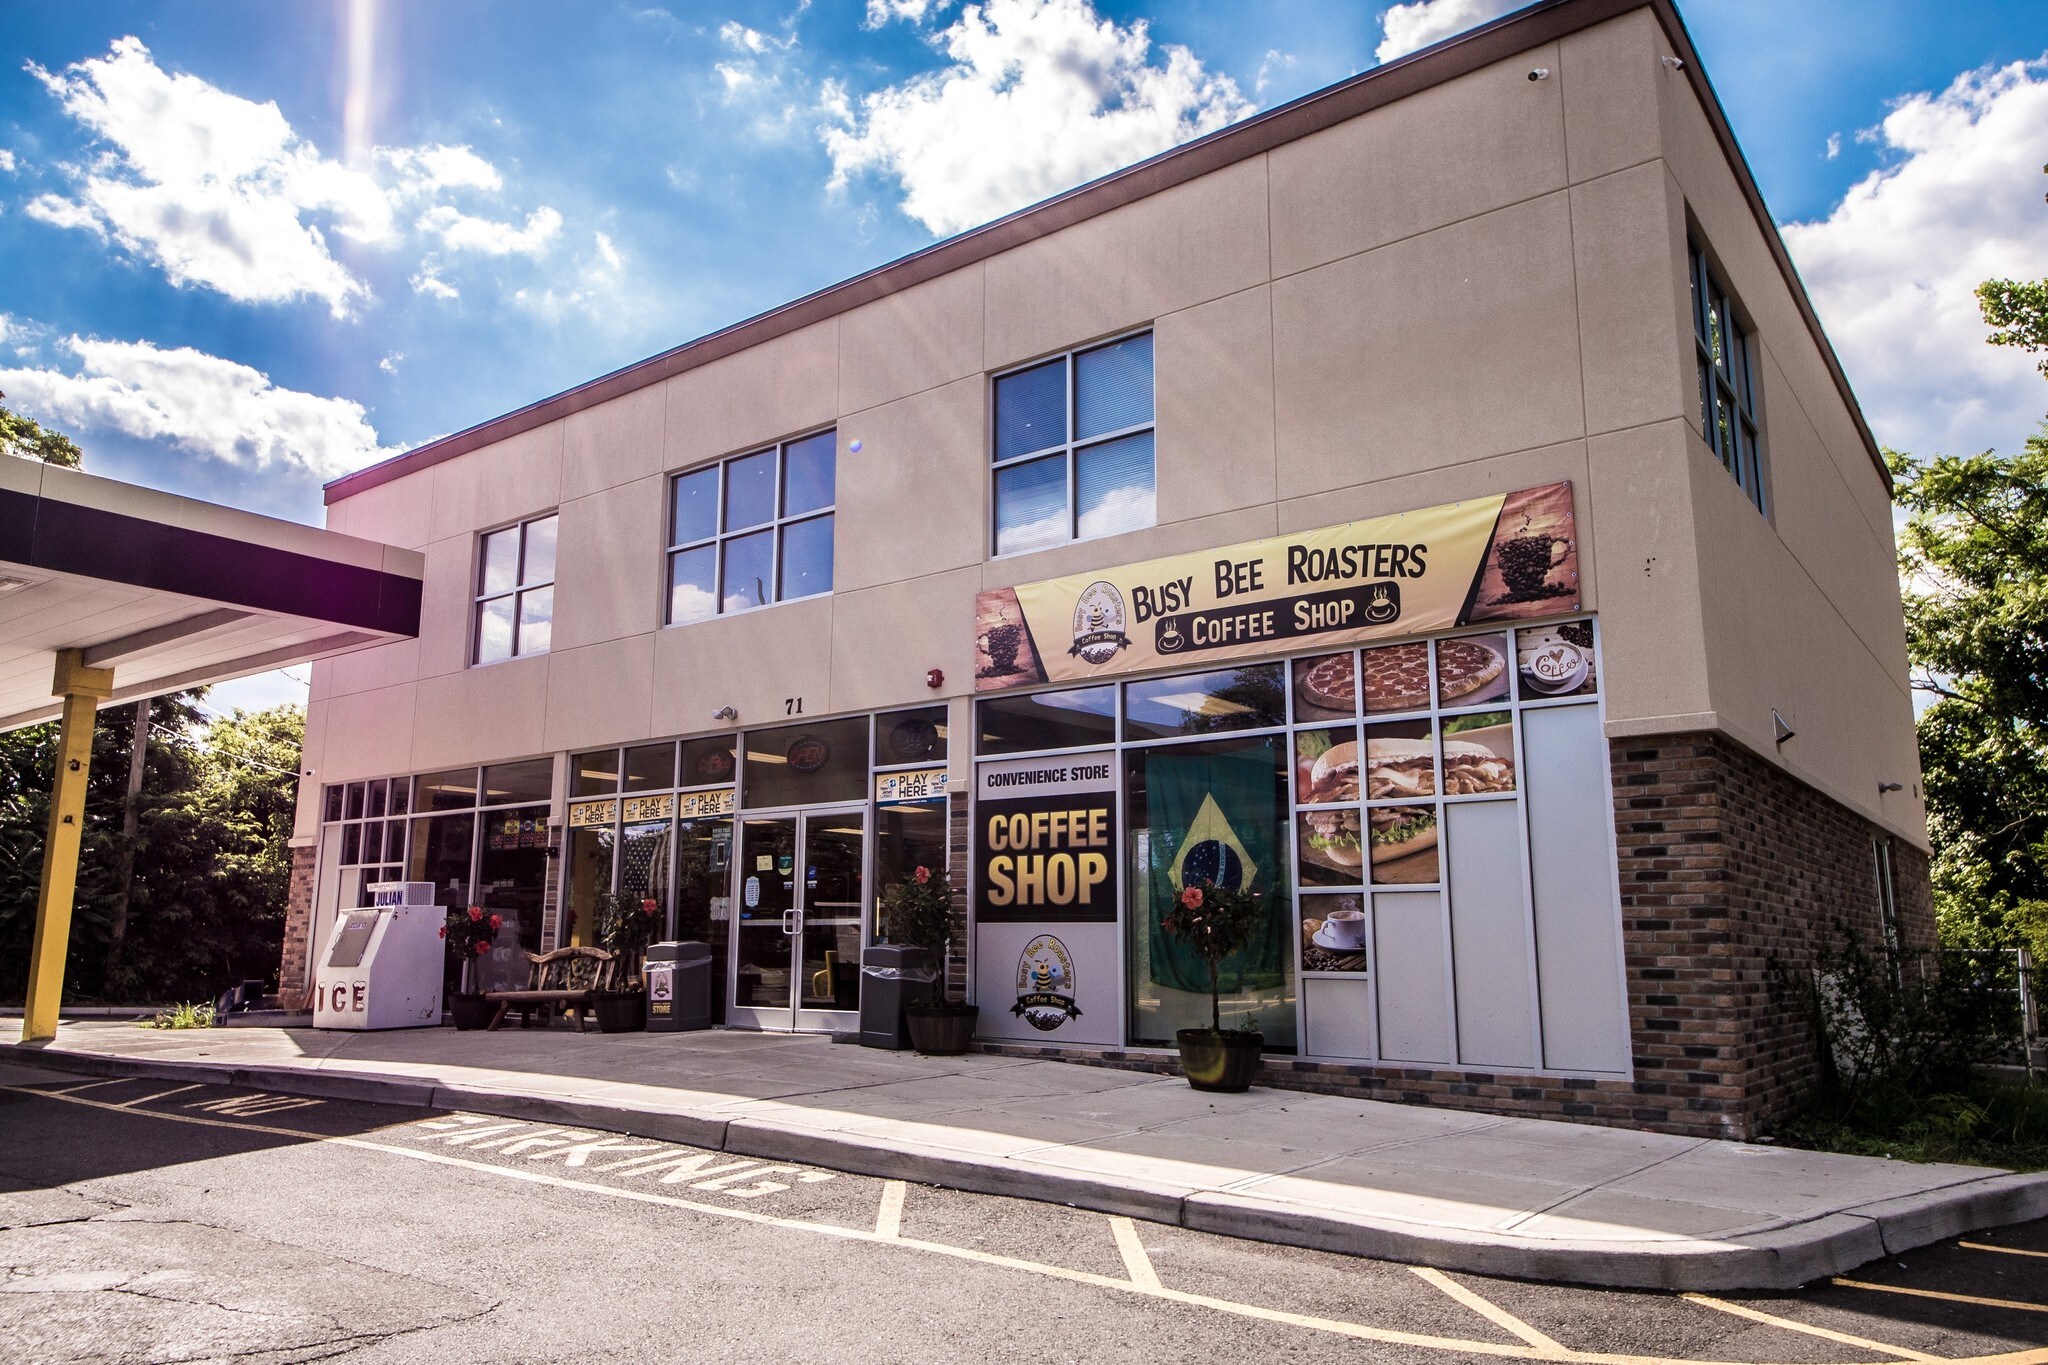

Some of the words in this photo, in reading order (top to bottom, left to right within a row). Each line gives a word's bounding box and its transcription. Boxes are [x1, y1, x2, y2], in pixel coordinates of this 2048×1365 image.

[1132, 575, 1193, 624] BUSY
[1214, 558, 1264, 599] BEE
[1287, 543, 1428, 586] ROASTERS
[1192, 610, 1275, 646] COFFEE
[1293, 599, 1355, 631] SHOP
[1081, 634, 1101, 644] Coffee
[1103, 632, 1117, 641] Shop
[1535, 654, 1580, 679] Coffee
[785, 697, 803, 715] 71
[899, 773, 928, 787] PLAY
[987, 768, 1067, 788] CONVENIENCE
[1070, 764, 1109, 781] STORE
[698, 792, 721, 804] PLAY
[898, 785, 927, 798] HERE
[585, 803, 606, 814] PLAY
[640, 798, 661, 809] PLAY
[698, 803, 720, 815] HERE
[584, 812, 605, 824] HERE
[639, 807, 660, 819] HERE
[988, 808, 1109, 851] COFFEE
[987, 852, 1108, 906] SHOP
[376, 890, 403, 907] JULIAN
[1026, 941, 1043, 958] Bee
[1048, 938, 1072, 990] Roasters
[318, 980, 366, 1013] ICE
[1026, 995, 1048, 1004] Coffee
[1050, 995, 1066, 1006] Shop
[652, 1005, 671, 1014] STORE
[415, 1115, 837, 1198] PARKING
